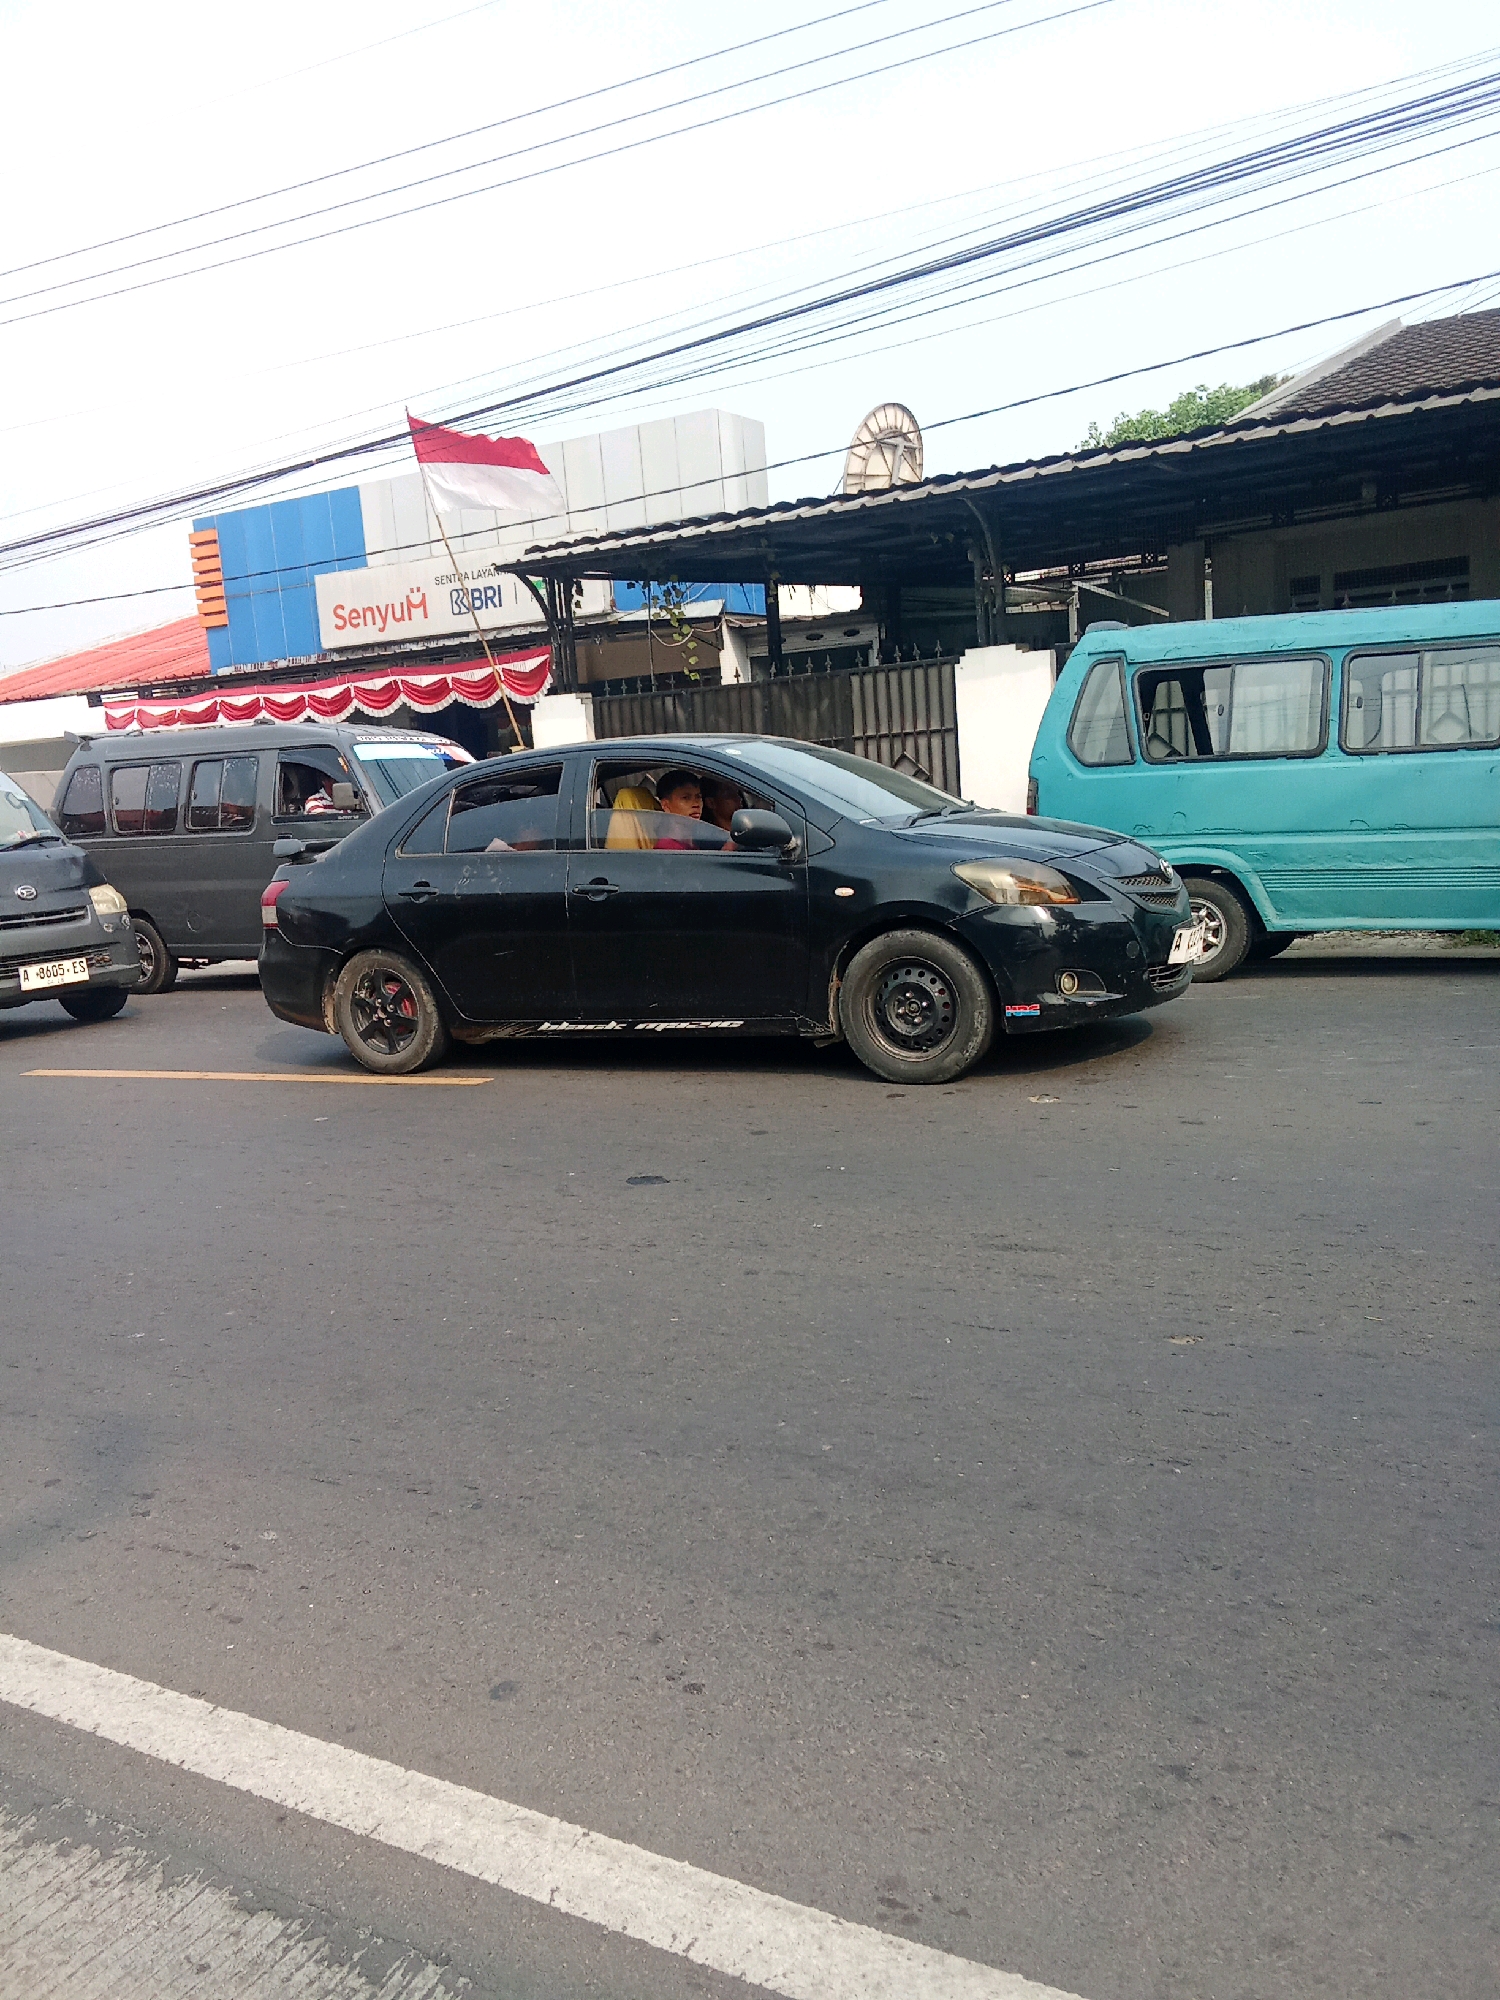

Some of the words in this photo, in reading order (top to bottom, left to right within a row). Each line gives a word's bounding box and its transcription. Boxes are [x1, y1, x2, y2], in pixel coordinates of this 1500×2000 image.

[470, 585, 503, 611] BRI
[23, 969, 30, 983] A
[39, 964, 65, 979] 8605
[72, 961, 86, 974] ES
